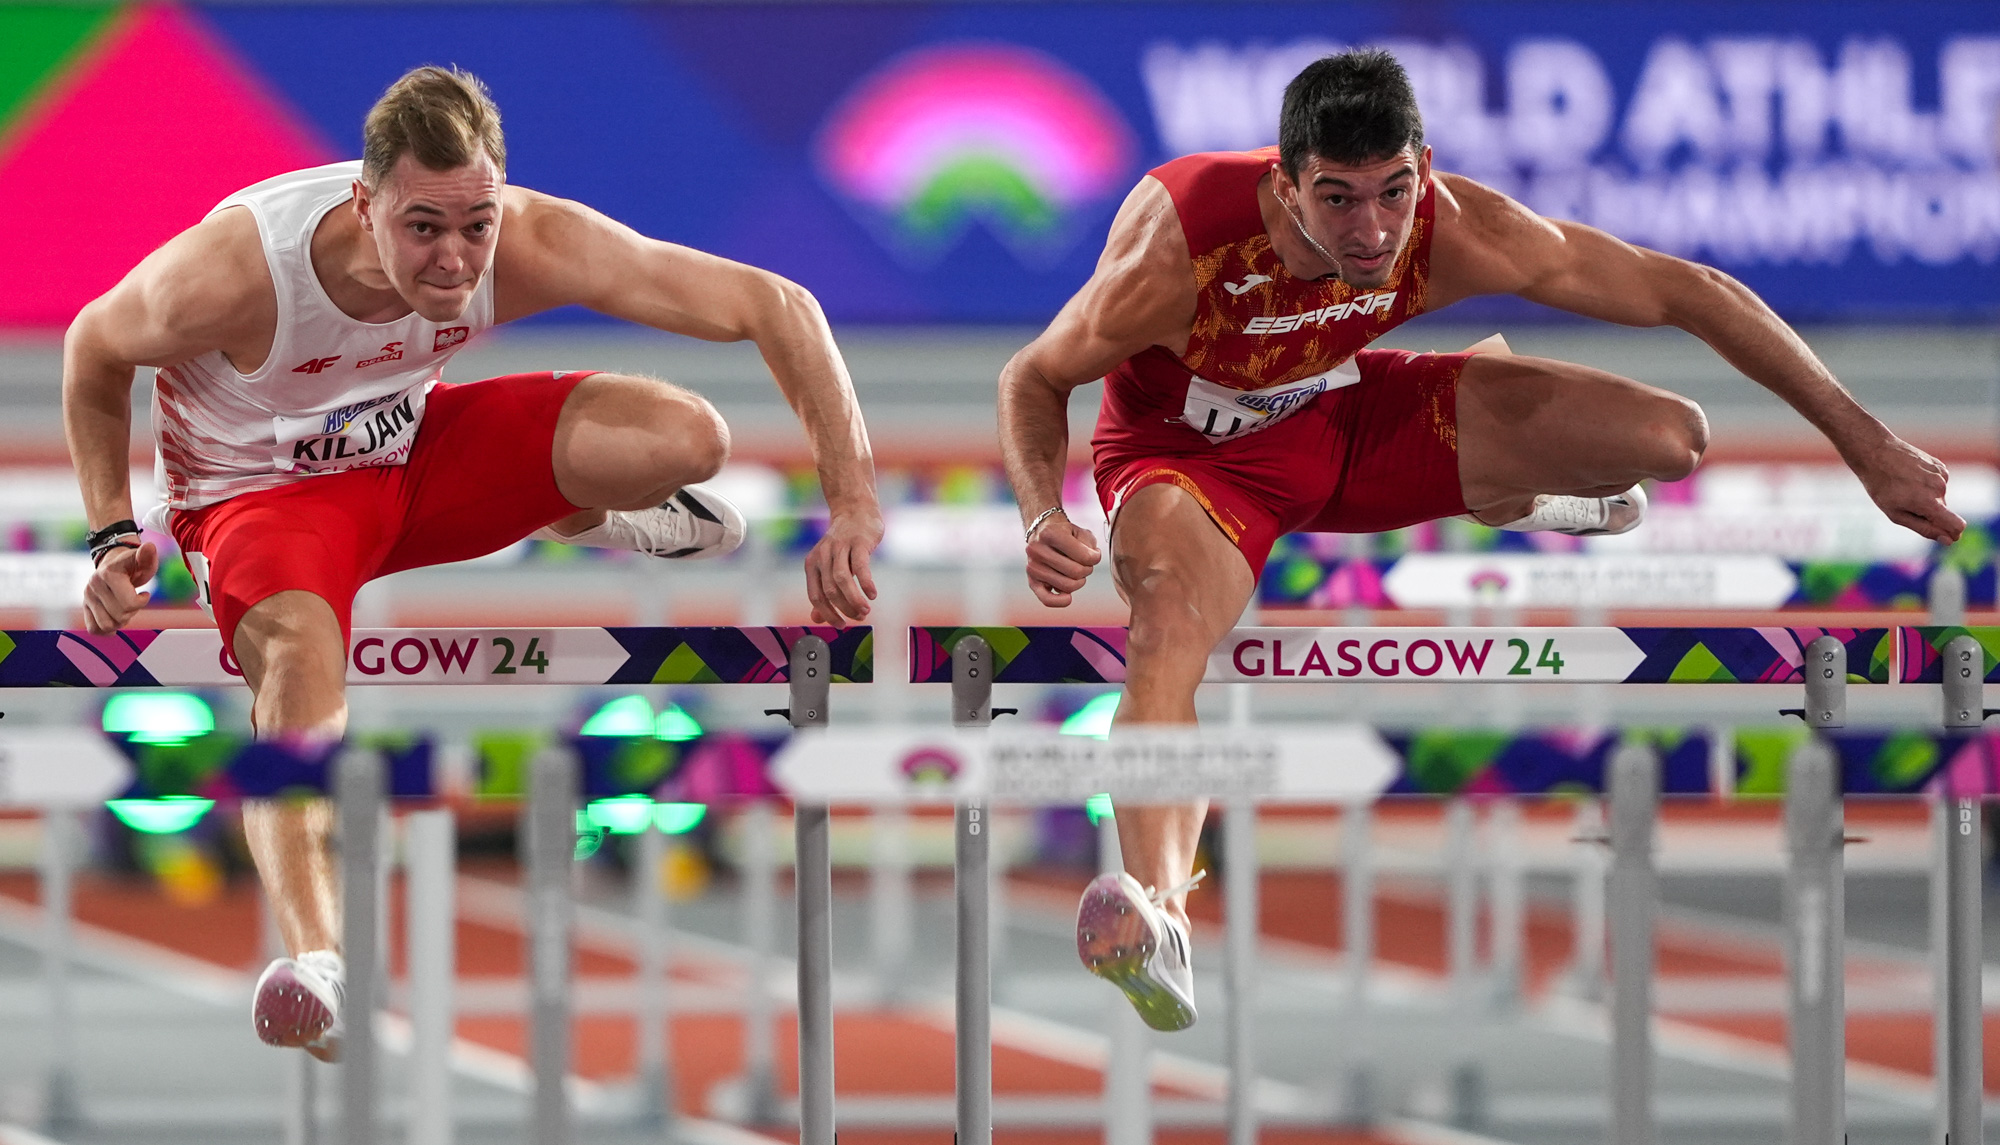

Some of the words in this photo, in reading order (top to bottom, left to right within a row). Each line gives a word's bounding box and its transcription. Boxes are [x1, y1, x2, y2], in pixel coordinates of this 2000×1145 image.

[1243, 291, 1397, 334] ESPAÑA
[292, 355, 342, 374] 4F
[358, 352, 401, 367] ORLEN
[293, 394, 415, 462] KILJAN
[219, 637, 479, 675] GGOW
[491, 637, 549, 674] 24
[1232, 638, 1494, 677] GLASGOW
[1507, 638, 1564, 675] 24
